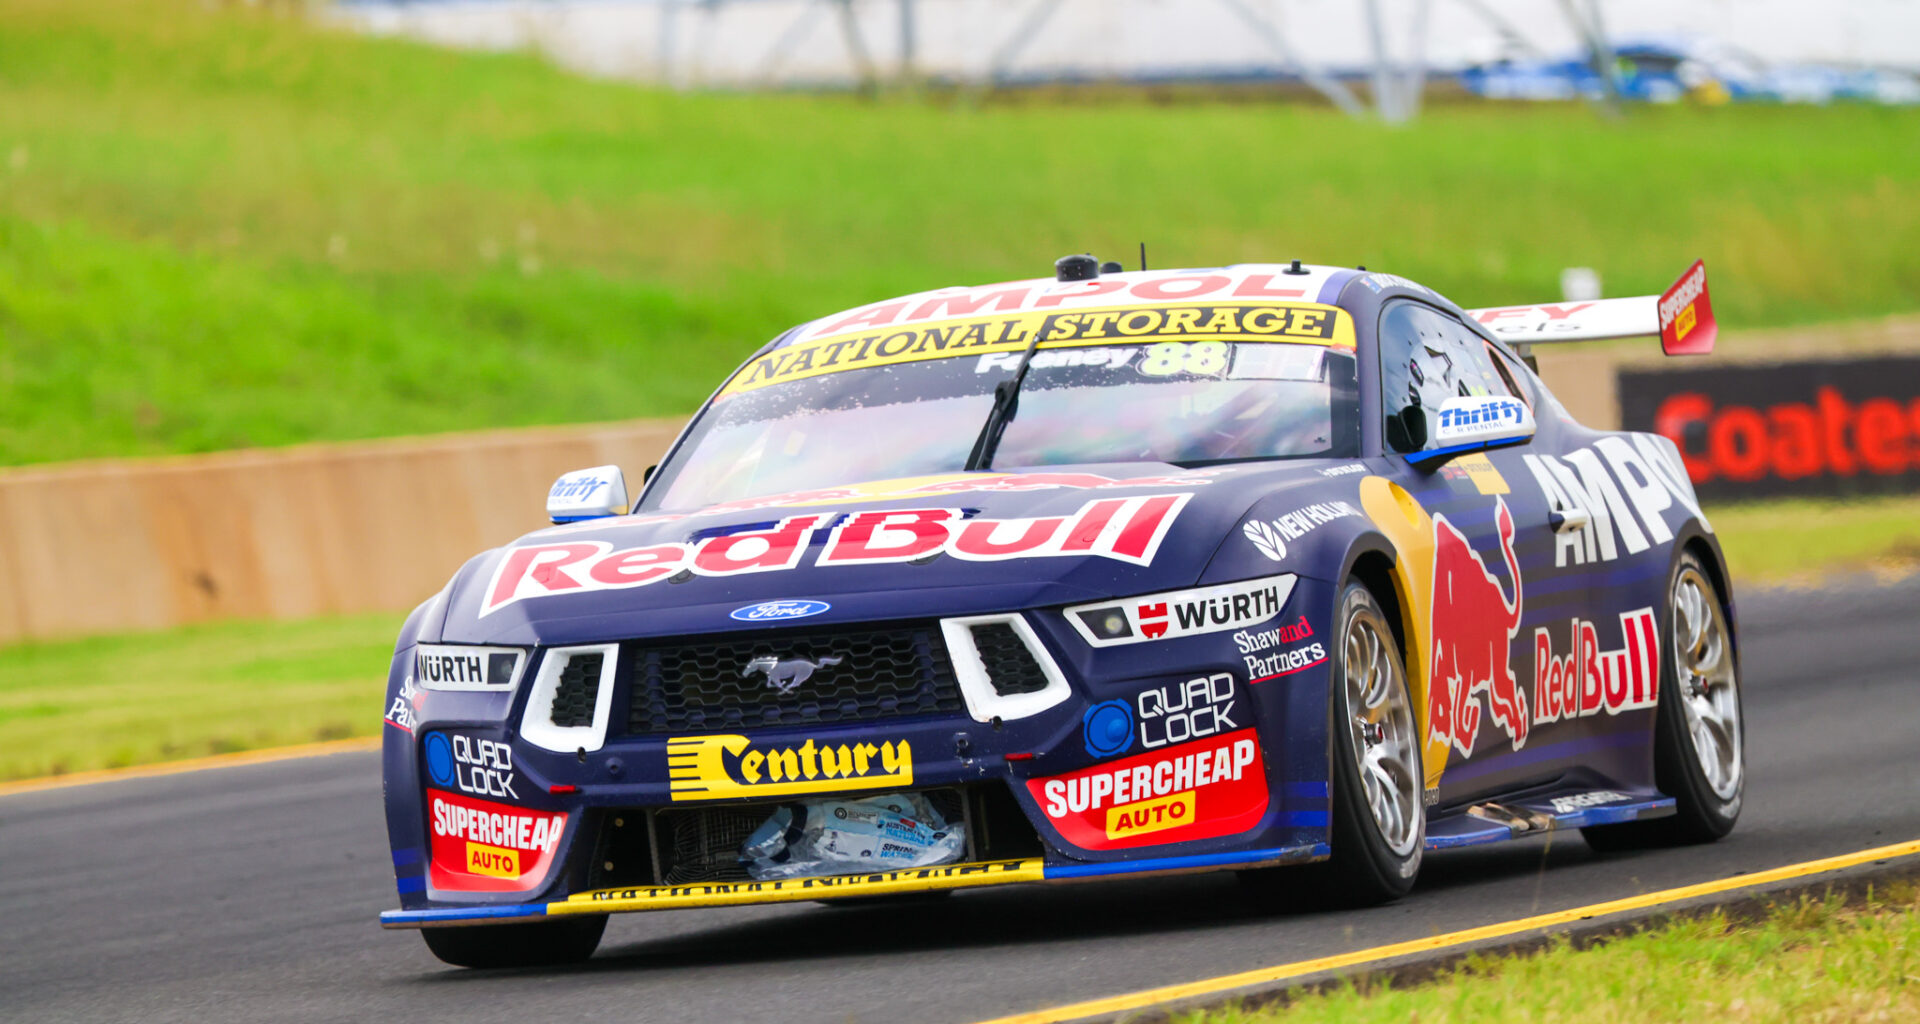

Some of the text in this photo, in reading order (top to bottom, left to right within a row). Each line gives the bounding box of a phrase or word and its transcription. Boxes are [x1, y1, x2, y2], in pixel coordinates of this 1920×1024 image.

[811, 274, 1306, 337] AMPOL
[743, 307, 1327, 386] NATIONAL STORAGE
[1140, 341, 1227, 376] 88
[1439, 401, 1523, 428] Thrifty
[1272, 508, 1317, 542] NEW
[482, 493, 1190, 613] Red Bull
[748, 602, 812, 618] Ford
[1174, 586, 1279, 630] WÜRTH
[1244, 642, 1326, 680] Partners
[1138, 672, 1235, 718] QUAD
[1140, 700, 1238, 749] LOCK
[453, 735, 512, 771] QUAD
[692, 735, 914, 797] Century
[456, 763, 519, 799] LOCK
[1044, 739, 1255, 818] SUPERCHEAP
[434, 798, 563, 854] SUPERCHEAP
[1115, 801, 1186, 831] AUTO
[472, 851, 513, 873] AUTO
